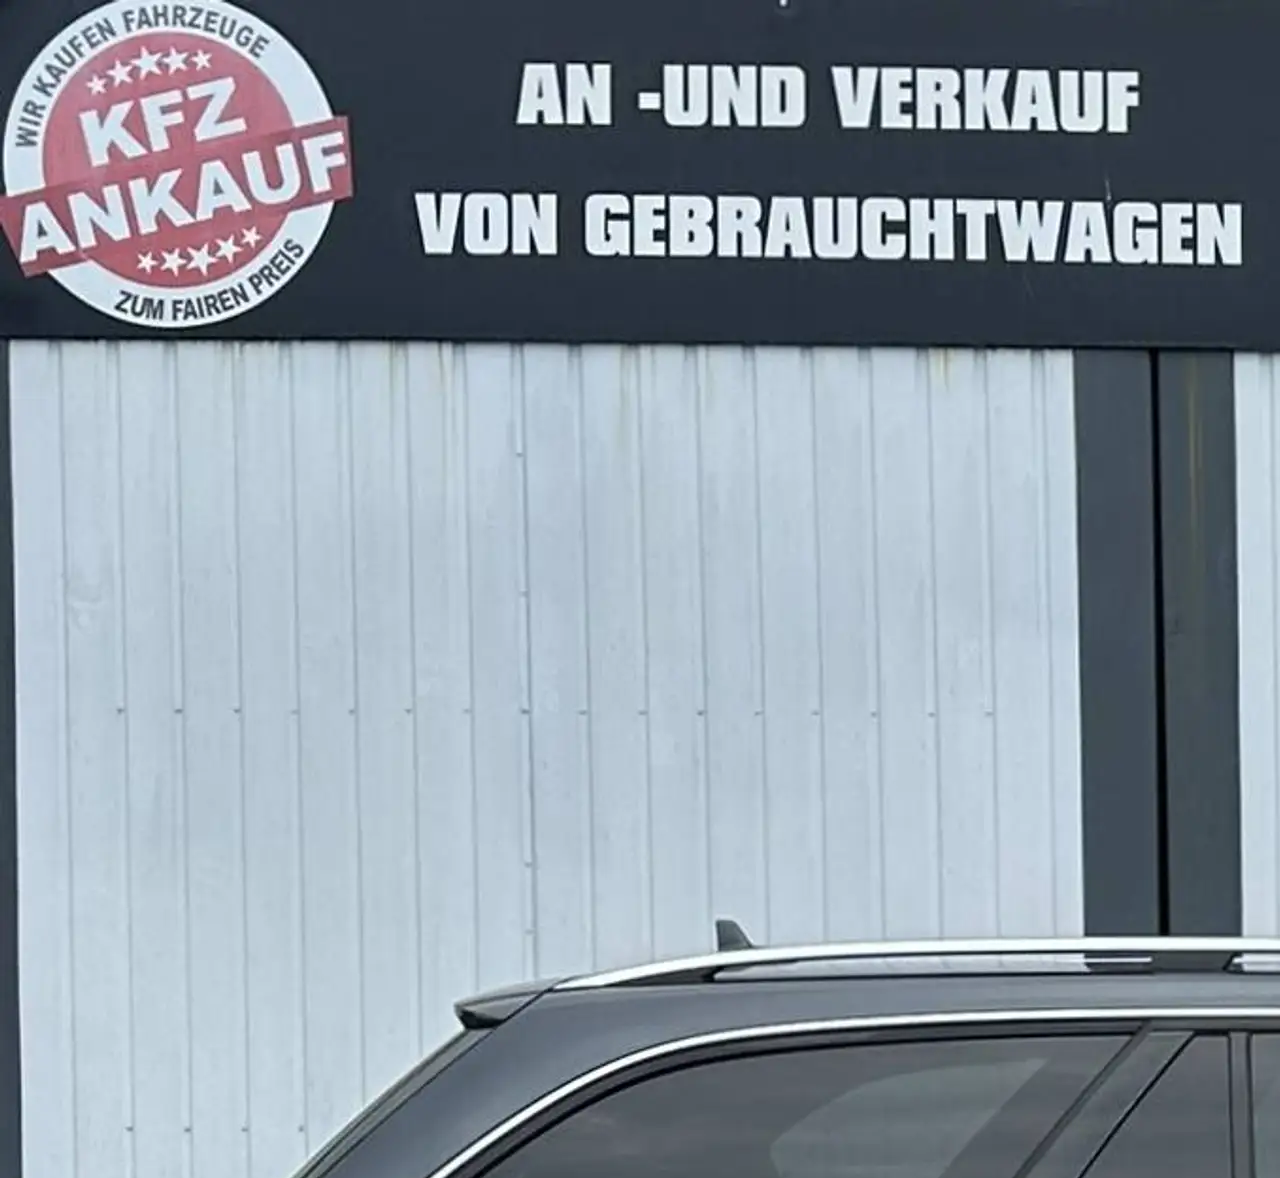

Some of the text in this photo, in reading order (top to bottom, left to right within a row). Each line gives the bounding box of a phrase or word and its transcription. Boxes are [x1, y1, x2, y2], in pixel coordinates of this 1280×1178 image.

[15, 5, 270, 149] WIR KAUFEN FAHRZEUGE
[515, 63, 612, 125] AN
[830, 66, 1141, 133] VERKAUF
[79, 76, 247, 168] KFZ
[20, 130, 347, 264] ANKAUF
[414, 191, 1243, 266] VON GEBRAUCHTWAGEN
[114, 238, 305, 321] ZUM FAIREN PREIS
